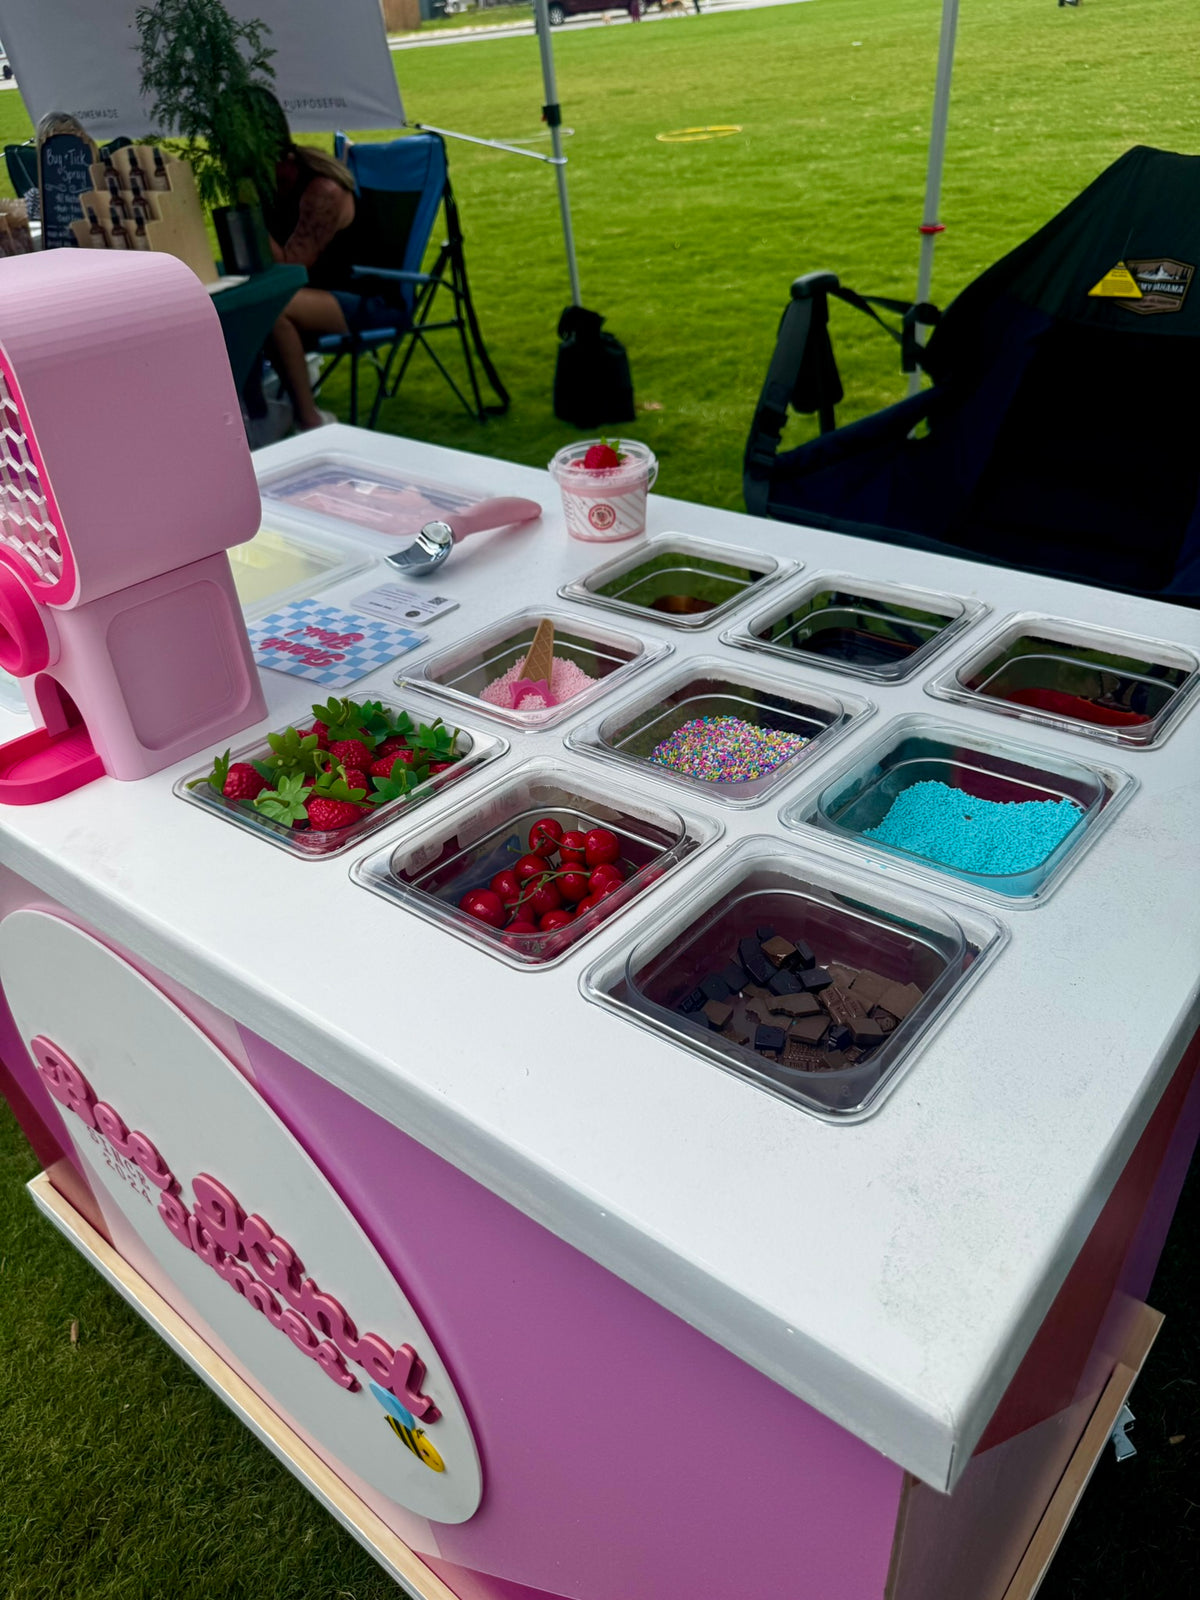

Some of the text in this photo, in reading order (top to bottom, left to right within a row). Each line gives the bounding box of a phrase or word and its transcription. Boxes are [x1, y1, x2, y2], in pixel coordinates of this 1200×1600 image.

[68, 148, 89, 166] Tick
[62, 168, 87, 189] Spray
[258, 637, 346, 667] Thank
[31, 1034, 442, 1425] Bee Kind
